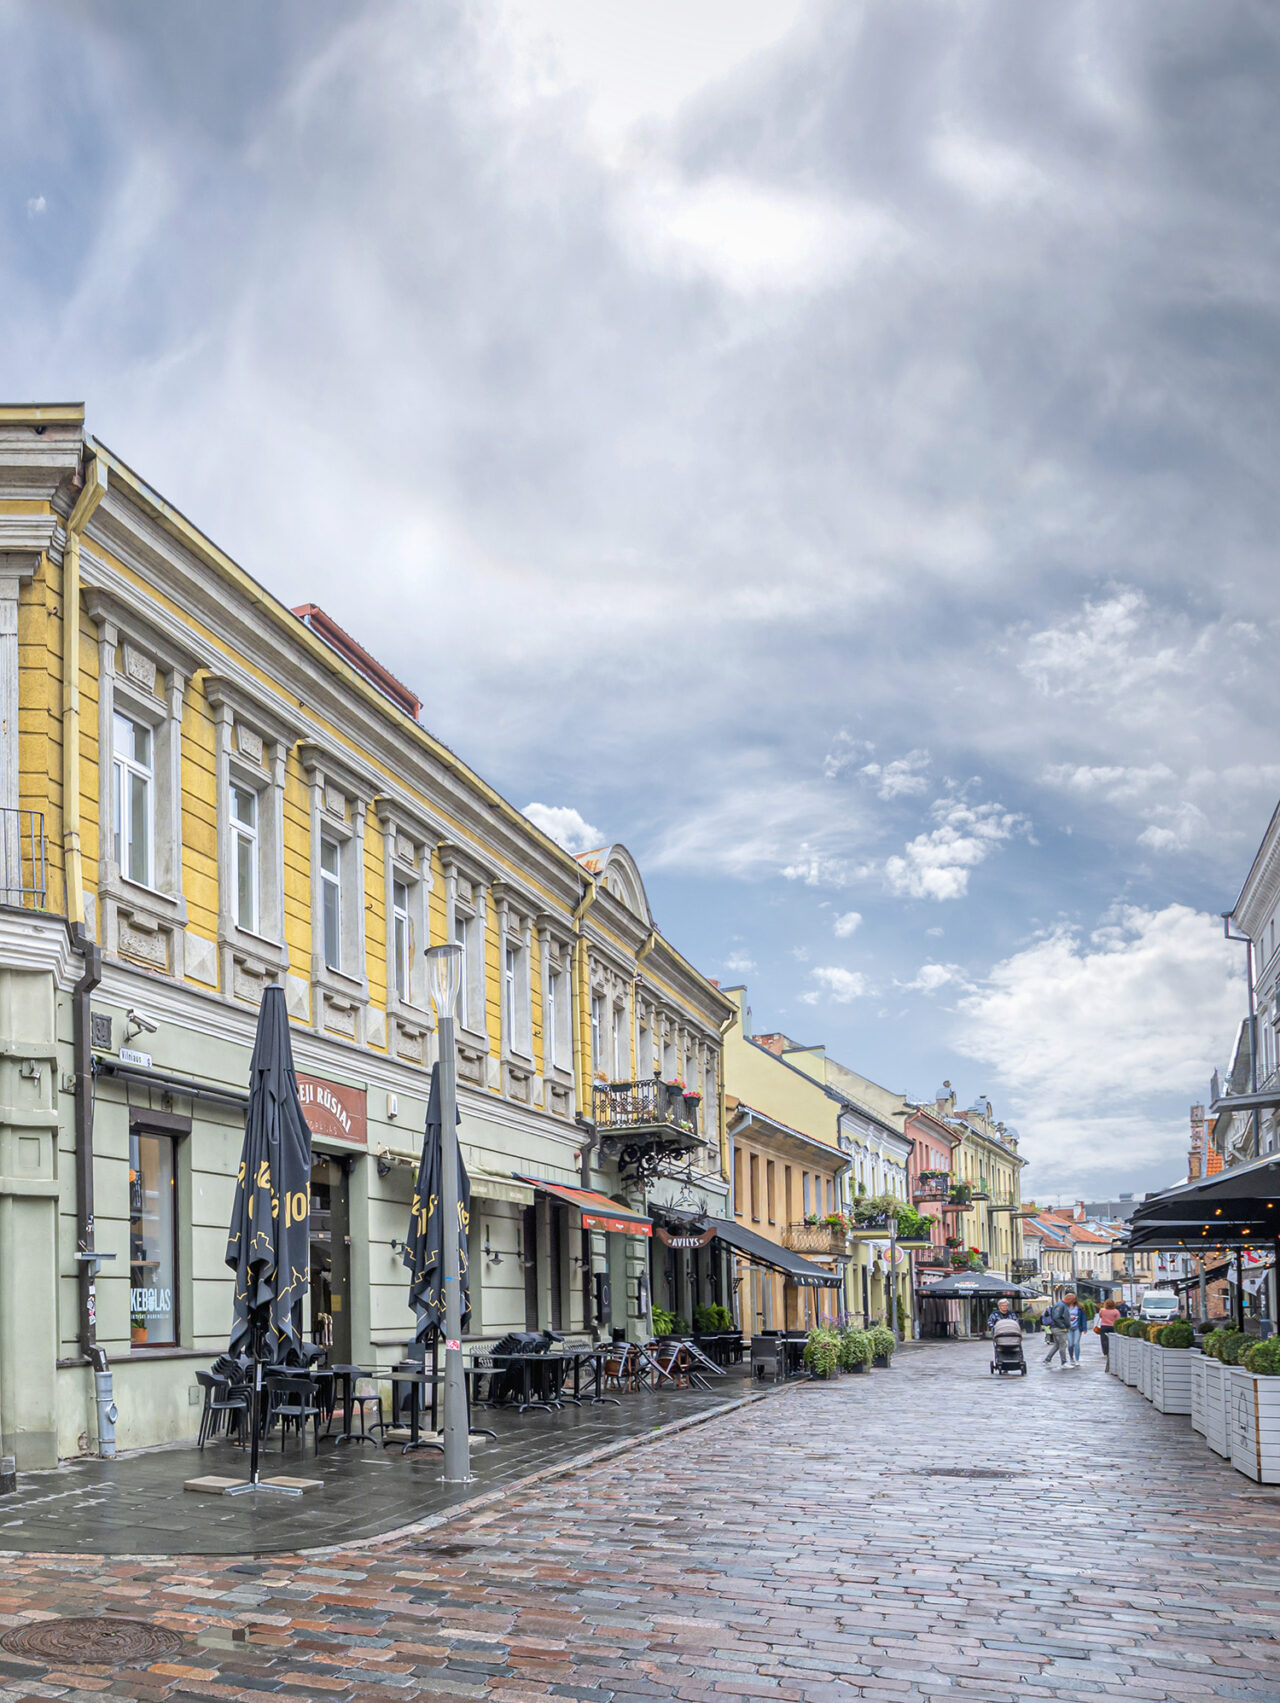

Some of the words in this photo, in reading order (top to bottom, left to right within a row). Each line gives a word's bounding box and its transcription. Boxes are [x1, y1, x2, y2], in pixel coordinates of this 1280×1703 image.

[297, 1084, 314, 1104] EJI
[316, 1086, 352, 1134] RŪSIAI
[671, 1237, 700, 1248] AVILYS
